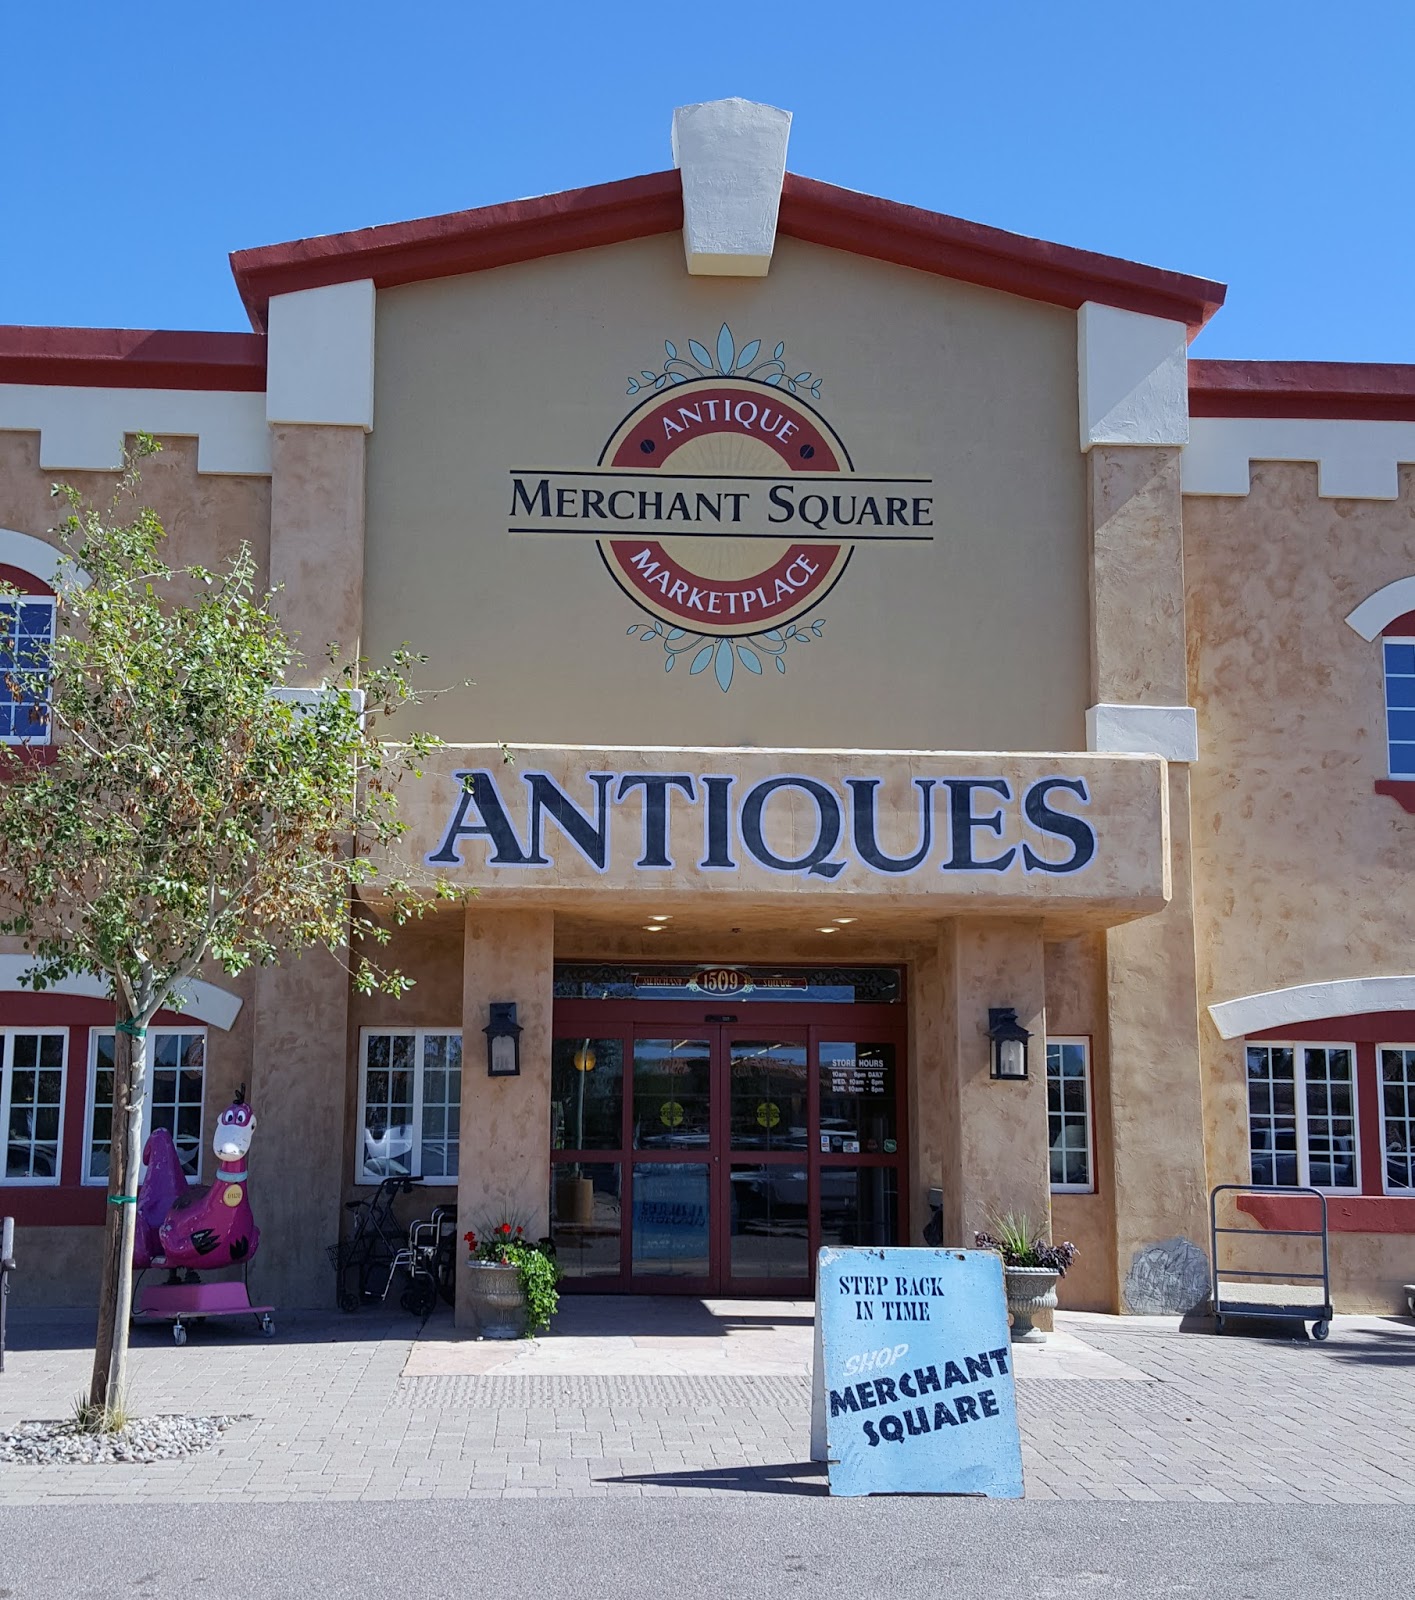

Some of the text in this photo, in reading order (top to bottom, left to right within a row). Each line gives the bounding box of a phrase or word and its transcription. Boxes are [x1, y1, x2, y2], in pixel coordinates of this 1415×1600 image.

[662, 399, 799, 444] ANTIQUE
[630, 547, 820, 615] MARKETPLACE
[424, 769, 1096, 880] ANTIQUES
[703, 970, 738, 991] 1509
[832, 1058, 884, 1068] STORE HOURS
[839, 1275, 945, 1297] STEP BACK
[855, 1300, 930, 1321] IN TIME
[842, 1343, 909, 1376] SHOP
[830, 1347, 1009, 1418] MERCHANT
[862, 1389, 999, 1447] SQUARE
